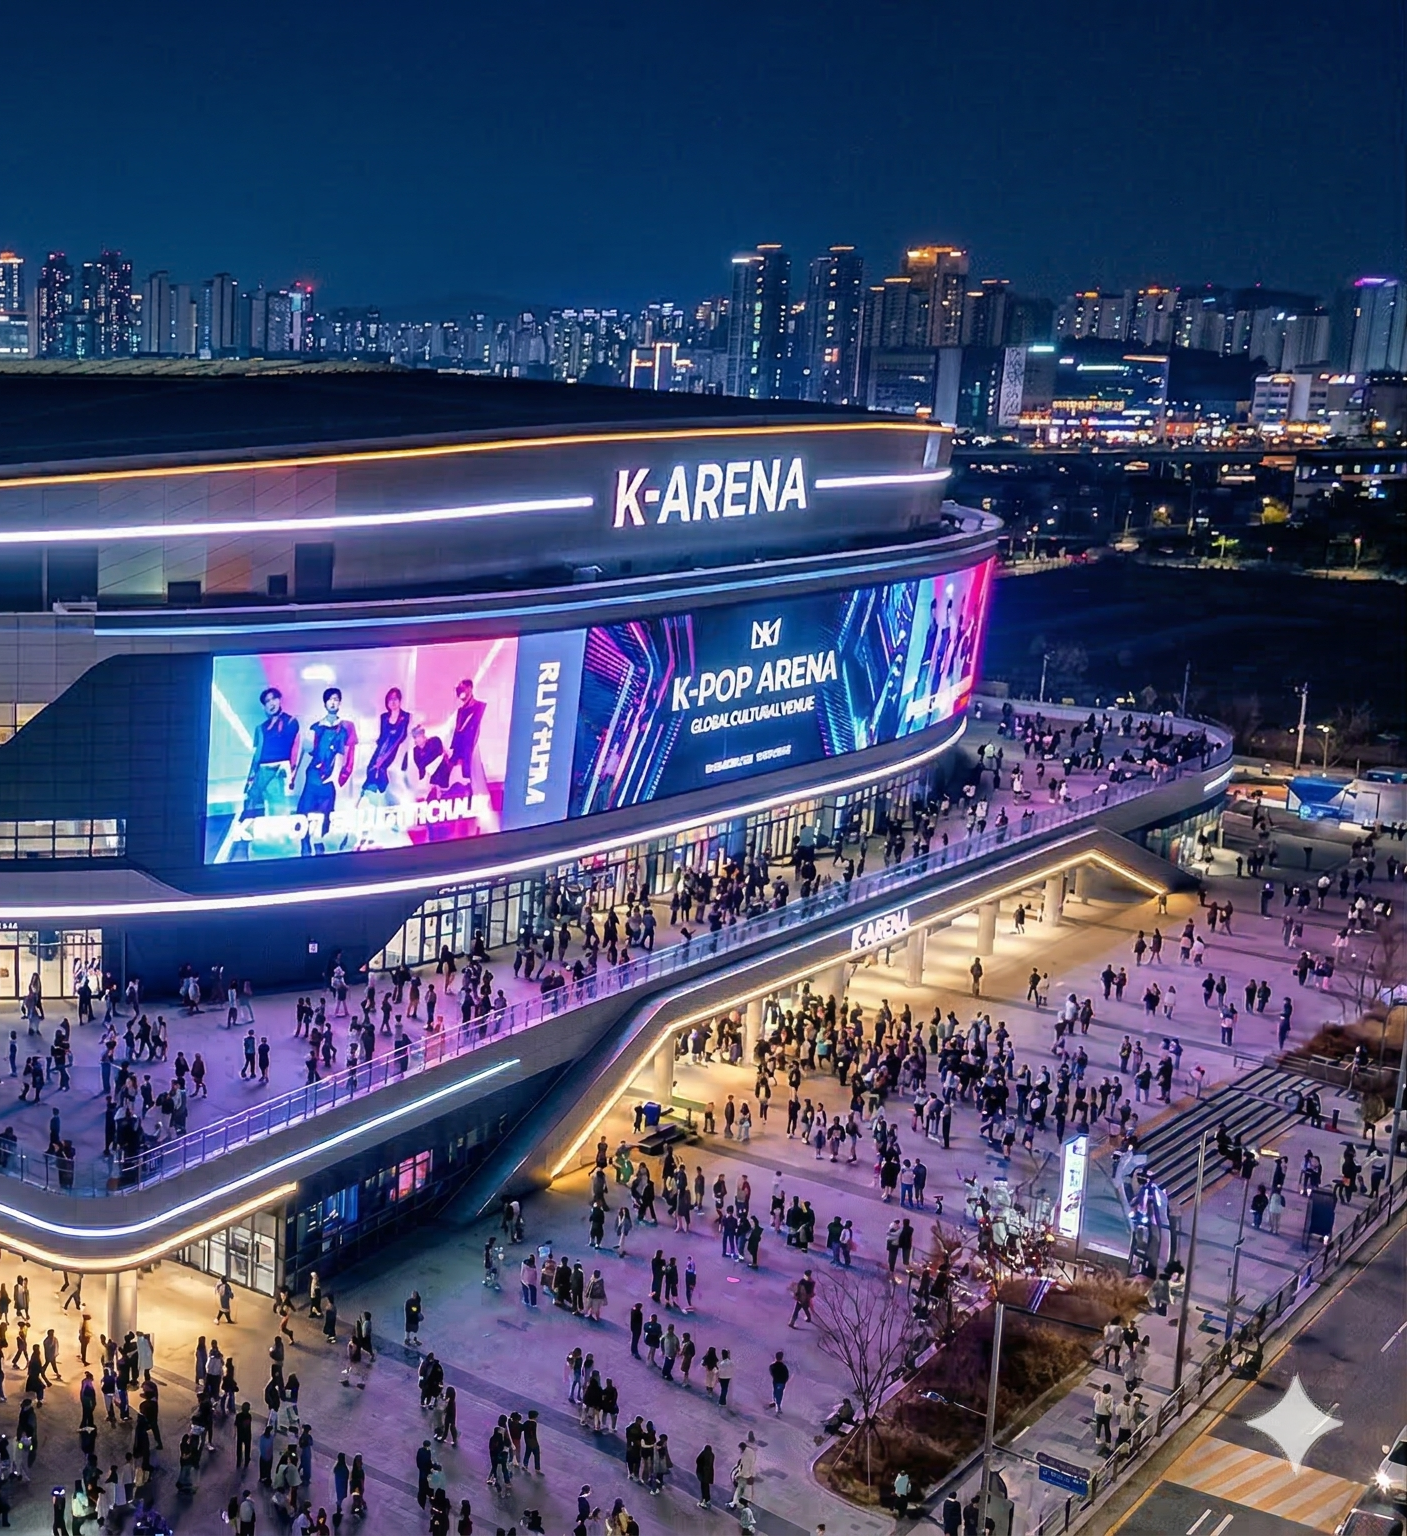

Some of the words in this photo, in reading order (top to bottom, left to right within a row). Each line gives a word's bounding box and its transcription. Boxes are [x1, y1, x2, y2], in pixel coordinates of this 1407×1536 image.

[613, 457, 807, 528] K-ARENA
[671, 666, 753, 711] K-POP
[755, 650, 838, 695] ARENA
